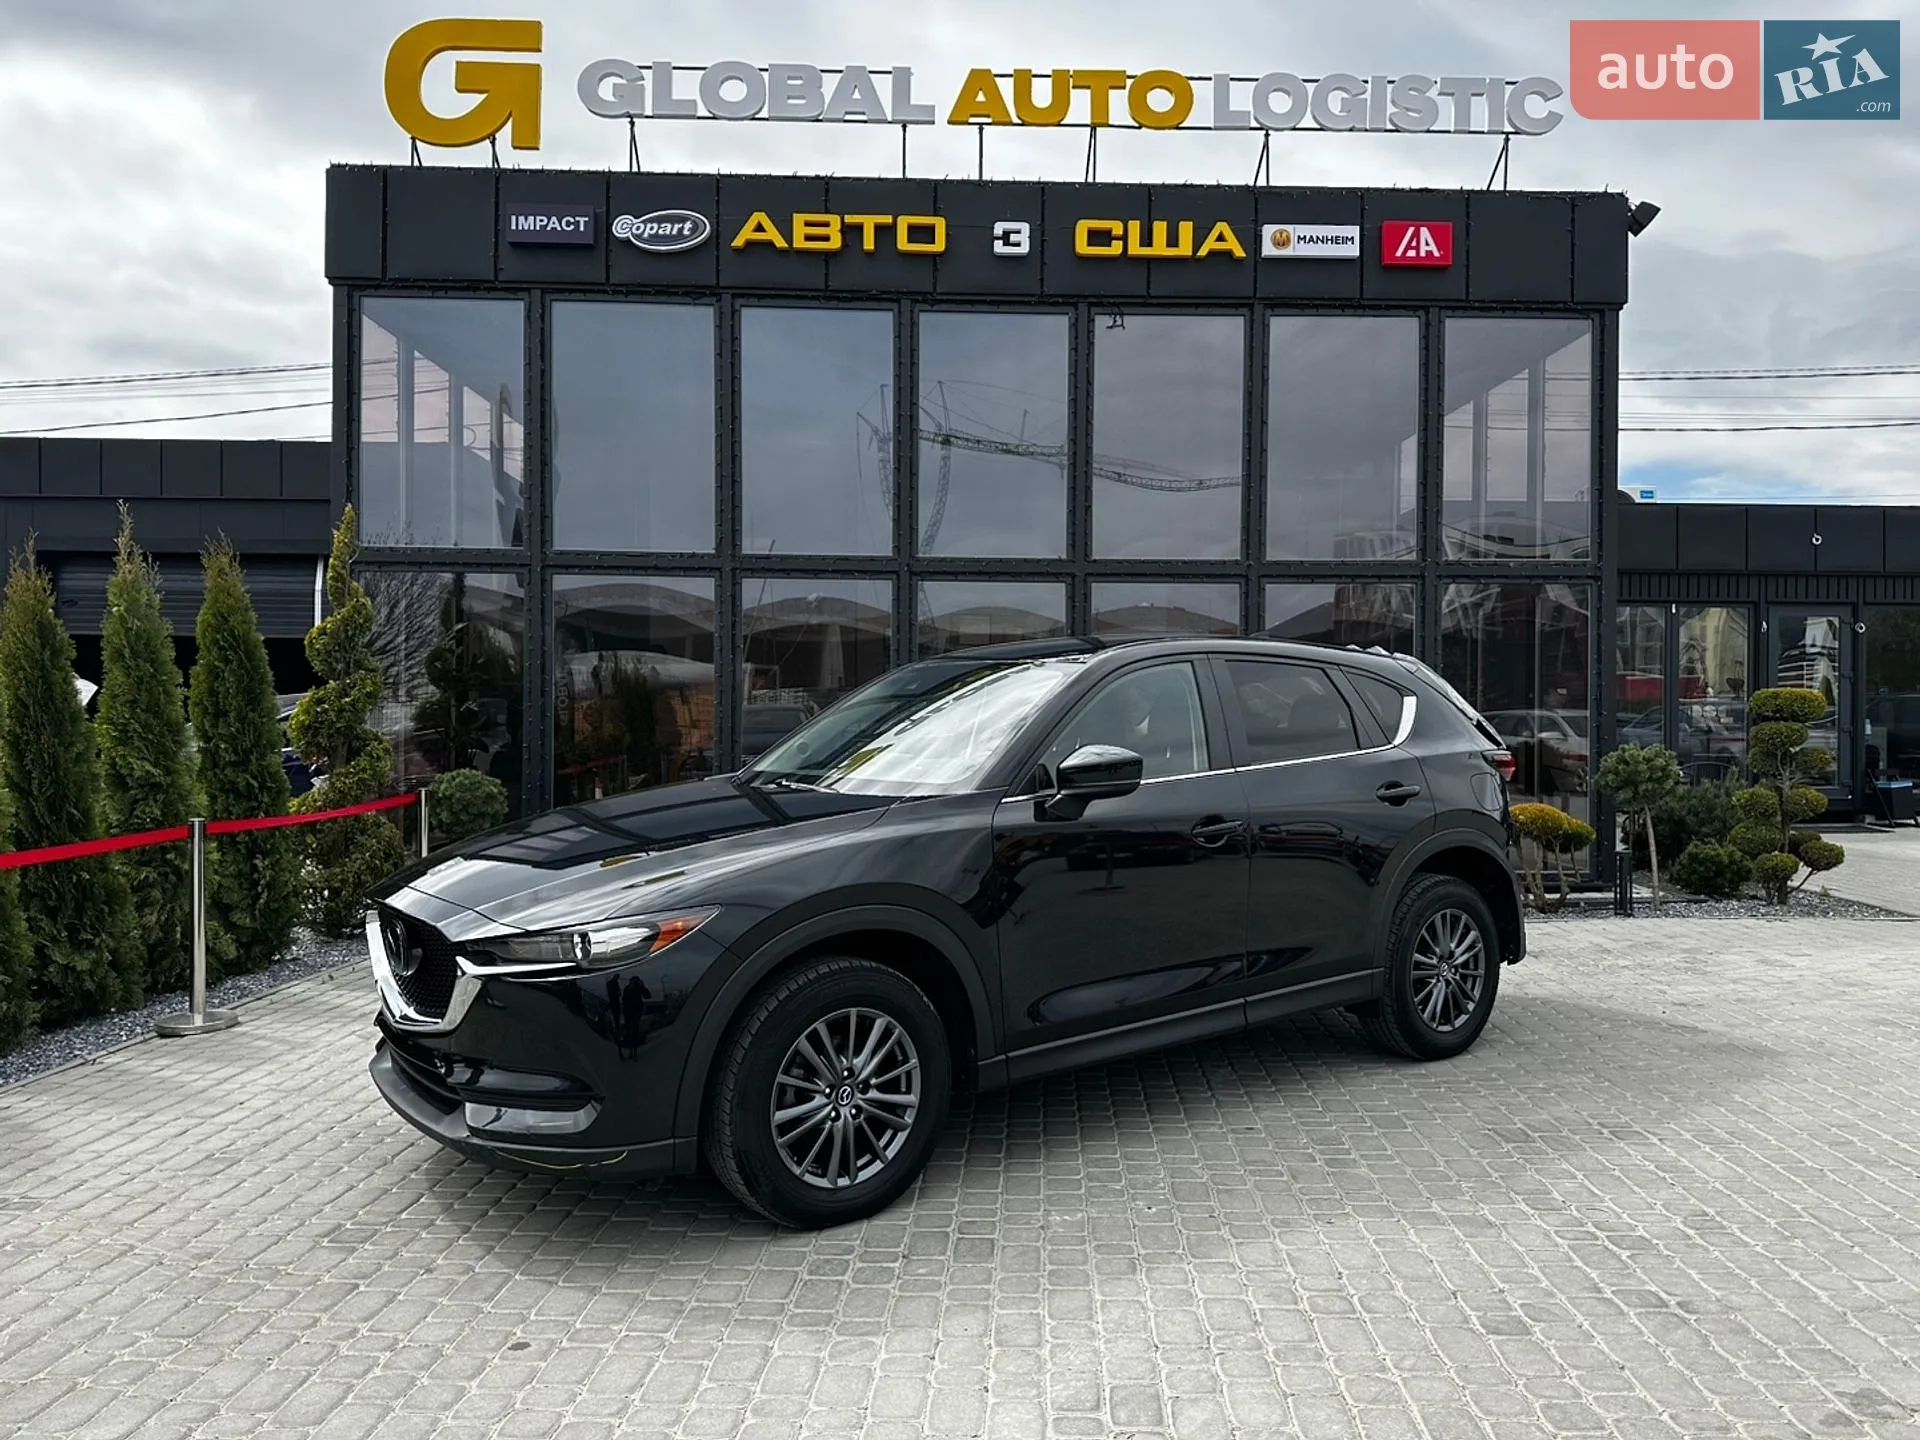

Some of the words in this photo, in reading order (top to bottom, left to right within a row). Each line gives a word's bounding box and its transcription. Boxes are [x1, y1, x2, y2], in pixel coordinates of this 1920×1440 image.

[577, 58, 935, 125] GLOBAL
[947, 68, 1194, 129] AUTO
[1212, 71, 1564, 136] LOGISTIC
[510, 214, 589, 231] IMPACT
[614, 216, 693, 238] Copart
[730, 211, 946, 255] АВТО
[1074, 219, 1246, 260] США
[1297, 234, 1355, 245] MANHEIM
